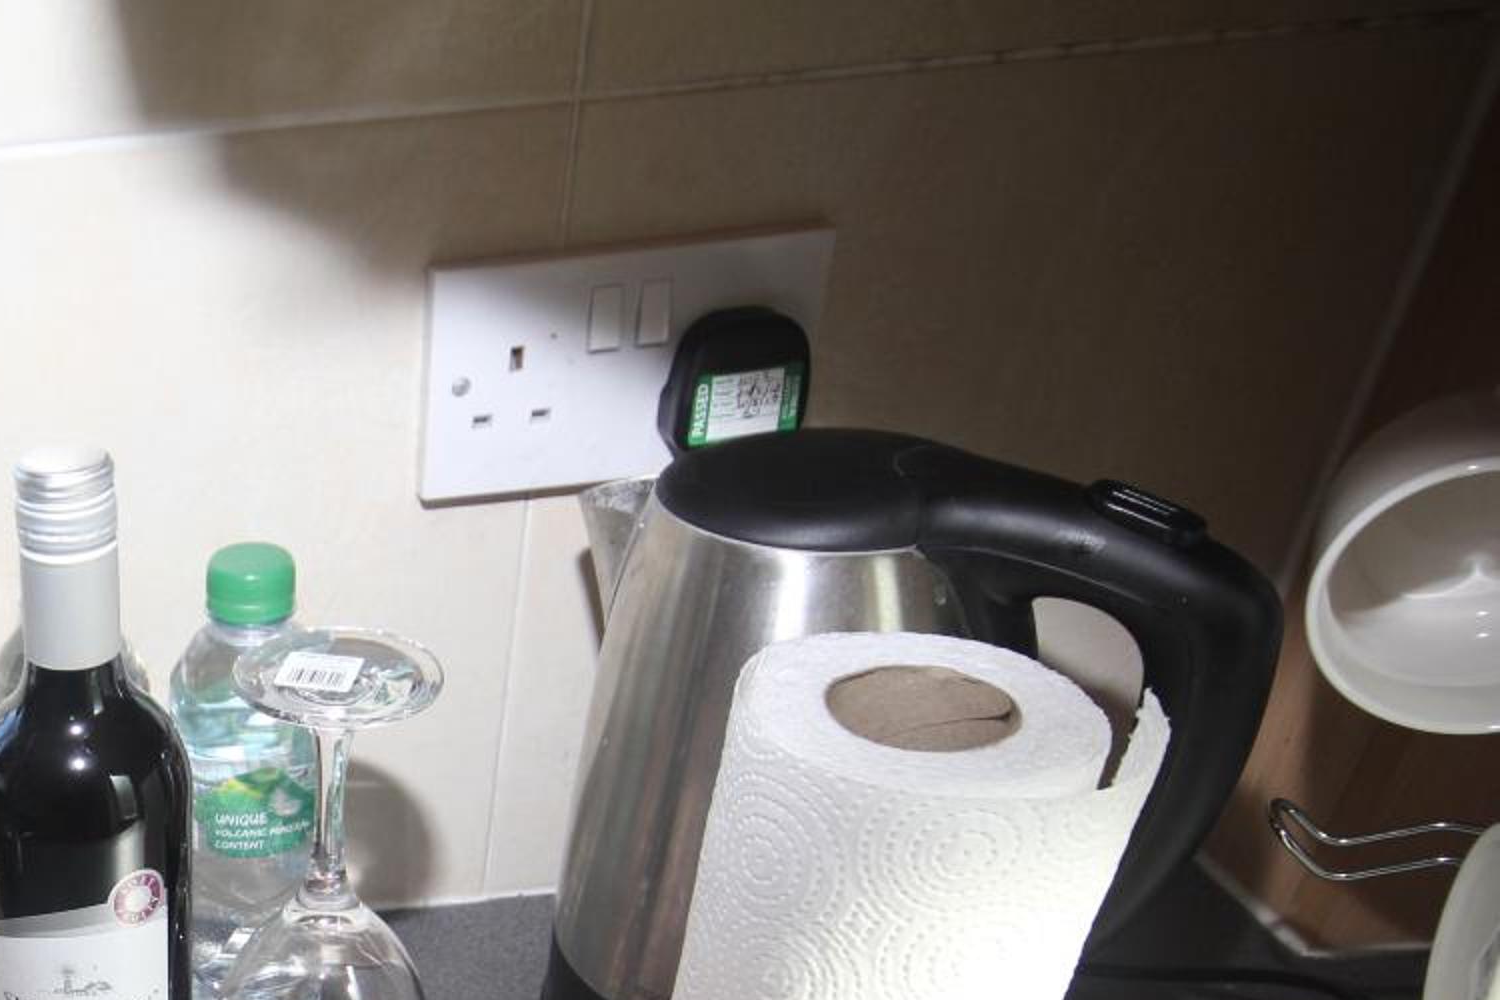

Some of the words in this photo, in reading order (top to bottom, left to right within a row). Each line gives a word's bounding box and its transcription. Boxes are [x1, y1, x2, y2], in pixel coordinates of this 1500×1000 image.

[690, 384, 709, 437] PASSED
[215, 812, 268, 827] UNIQUE
[214, 840, 264, 850] CONTENT
